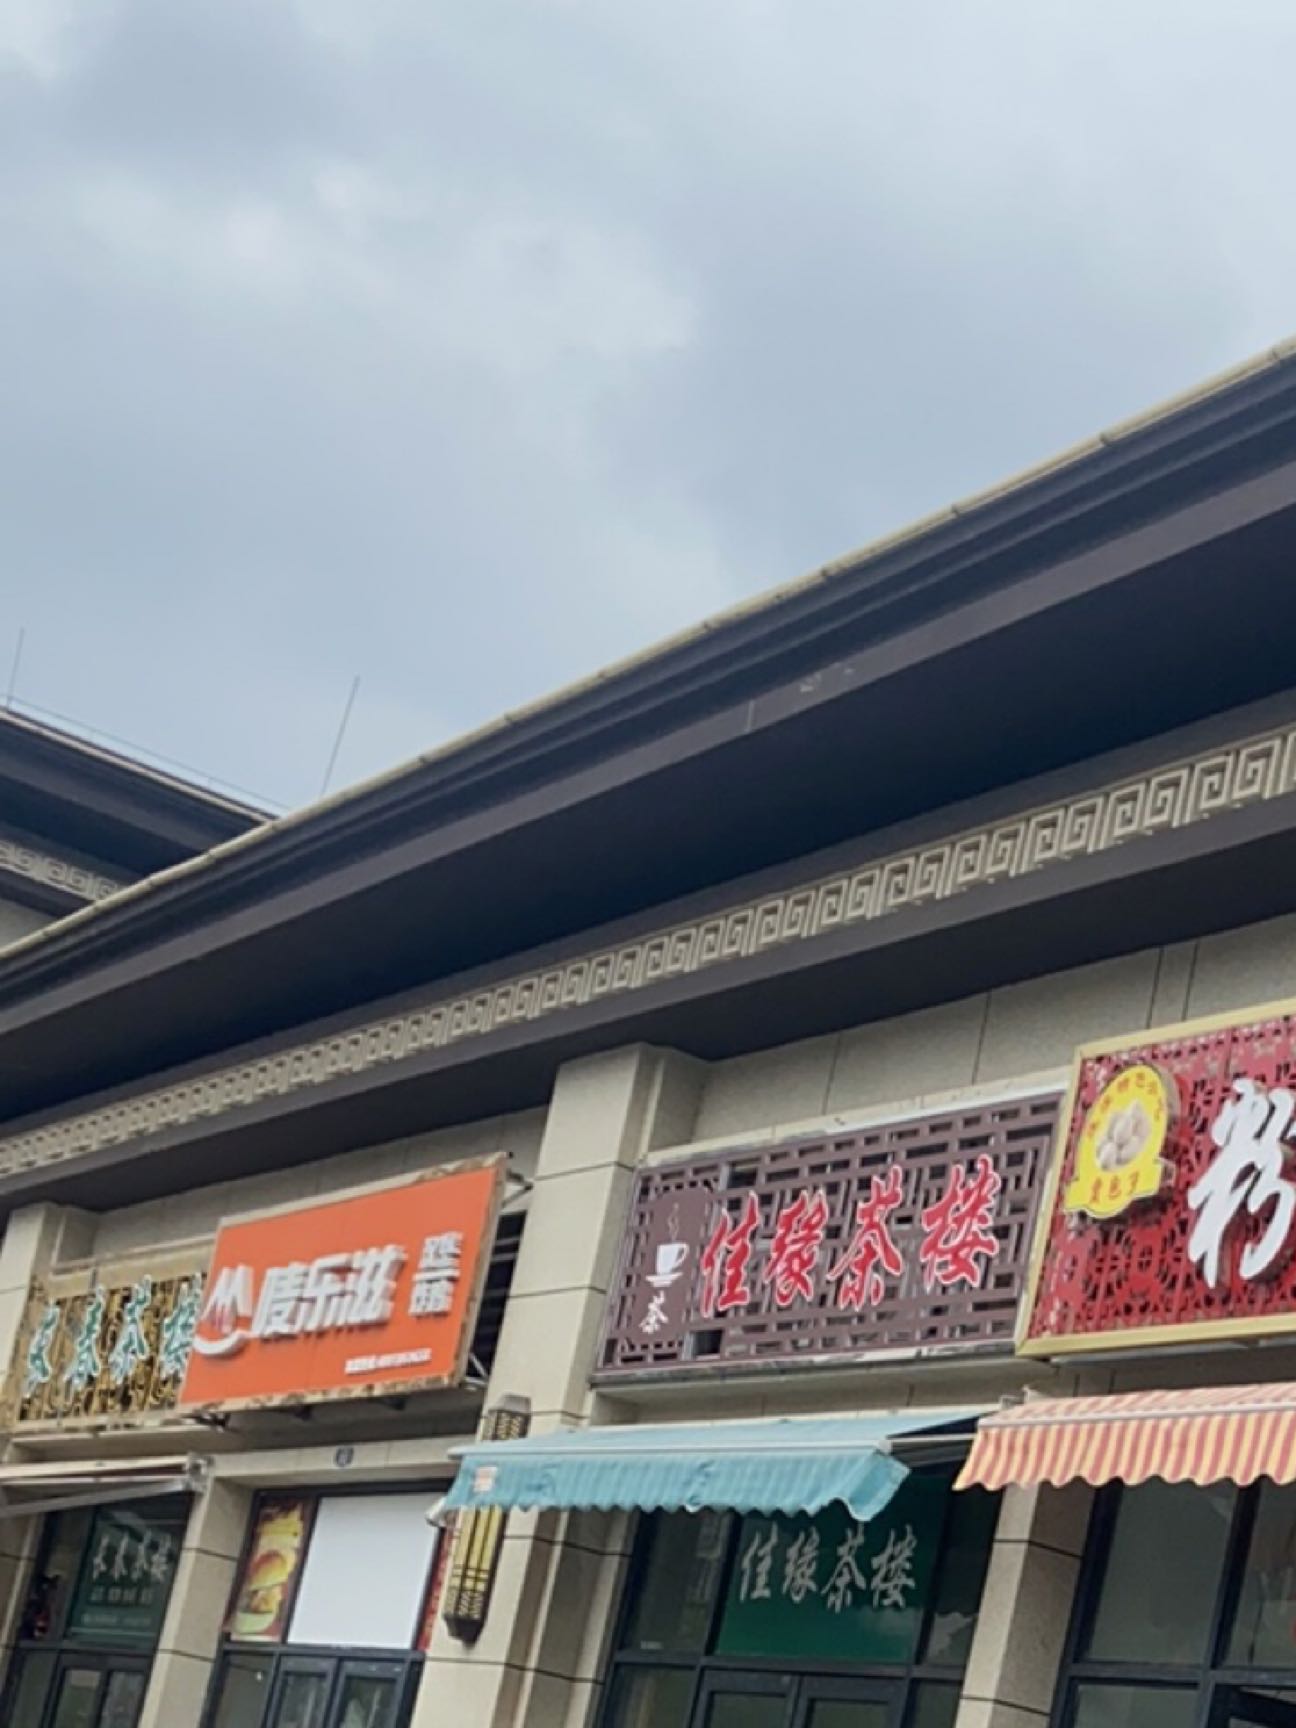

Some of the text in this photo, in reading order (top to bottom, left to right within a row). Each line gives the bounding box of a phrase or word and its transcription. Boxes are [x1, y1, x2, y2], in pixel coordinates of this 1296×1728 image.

[638, 1290, 669, 1334] 茶
[740, 1520, 917, 1614] 佳缘茶楼
